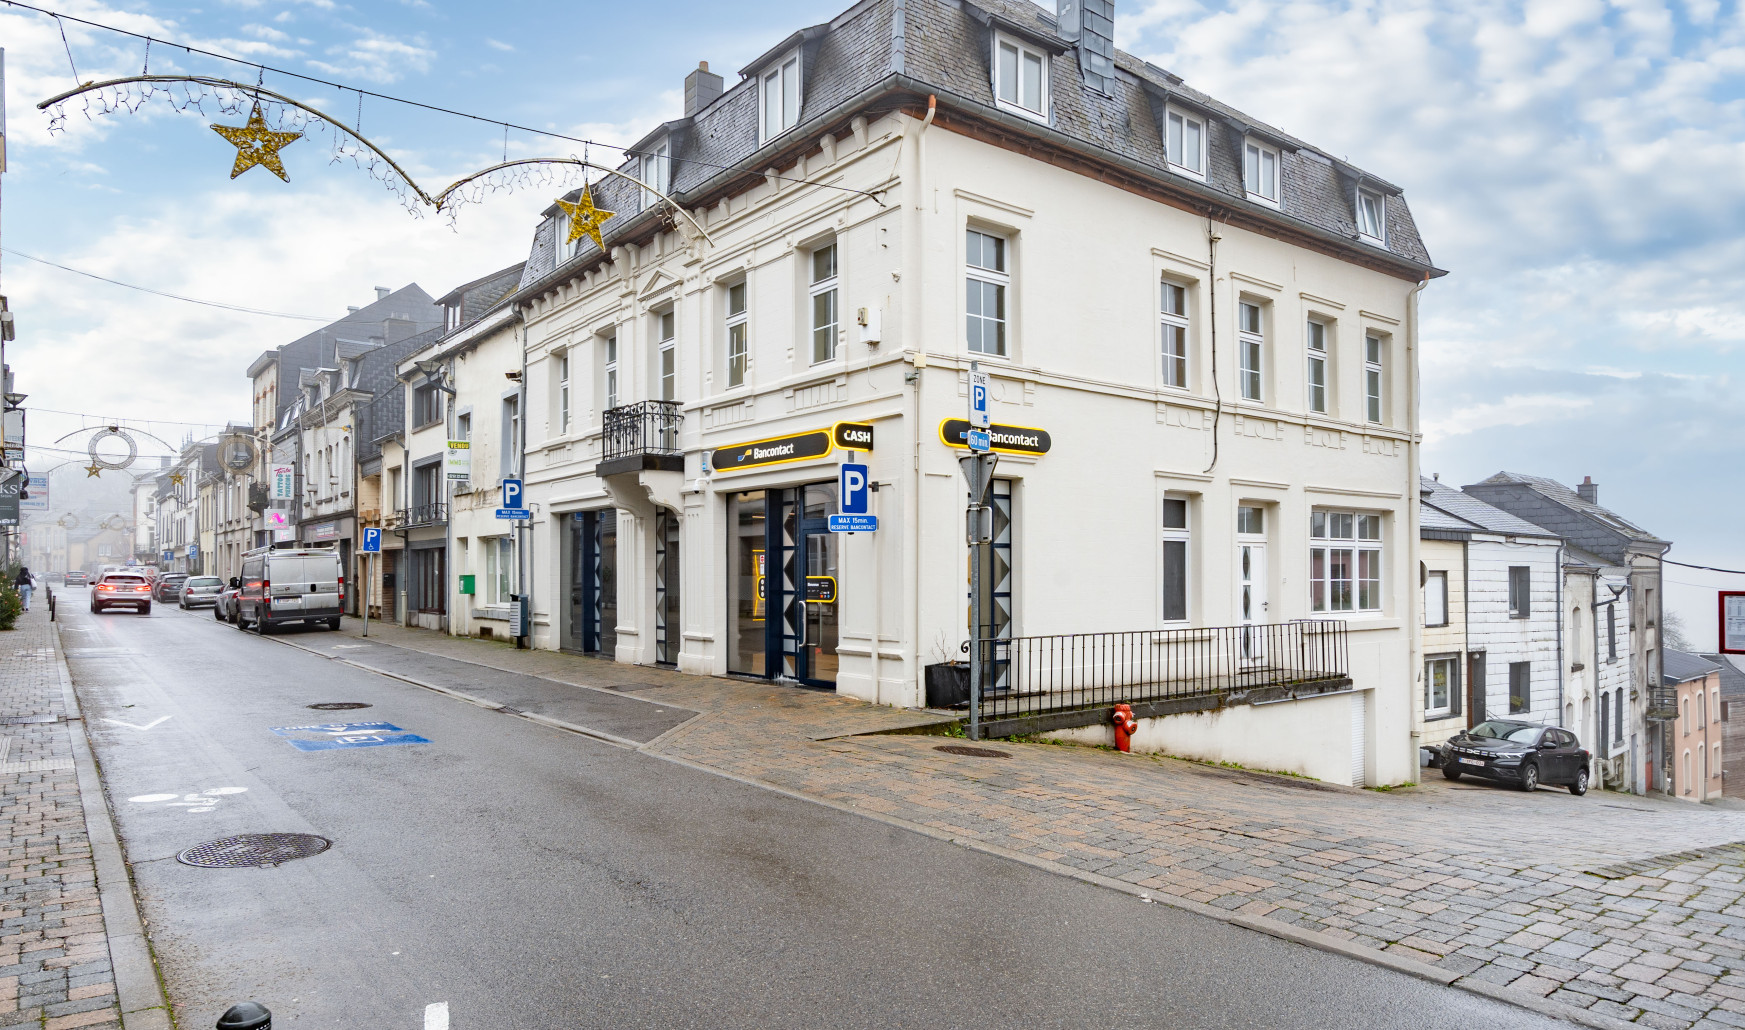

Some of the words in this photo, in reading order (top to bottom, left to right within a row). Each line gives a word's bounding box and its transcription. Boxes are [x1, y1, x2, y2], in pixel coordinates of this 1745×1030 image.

[974, 374, 986, 384] ZONE
[975, 387, 984, 409] P
[844, 430, 870, 442] CASH
[970, 434, 978, 446] 60
[985, 429, 1039, 447] Bancontact
[753, 443, 794, 459] Bancontact
[505, 483, 520, 504] P
[845, 470, 865, 506] P
[367, 530, 378, 542] P
